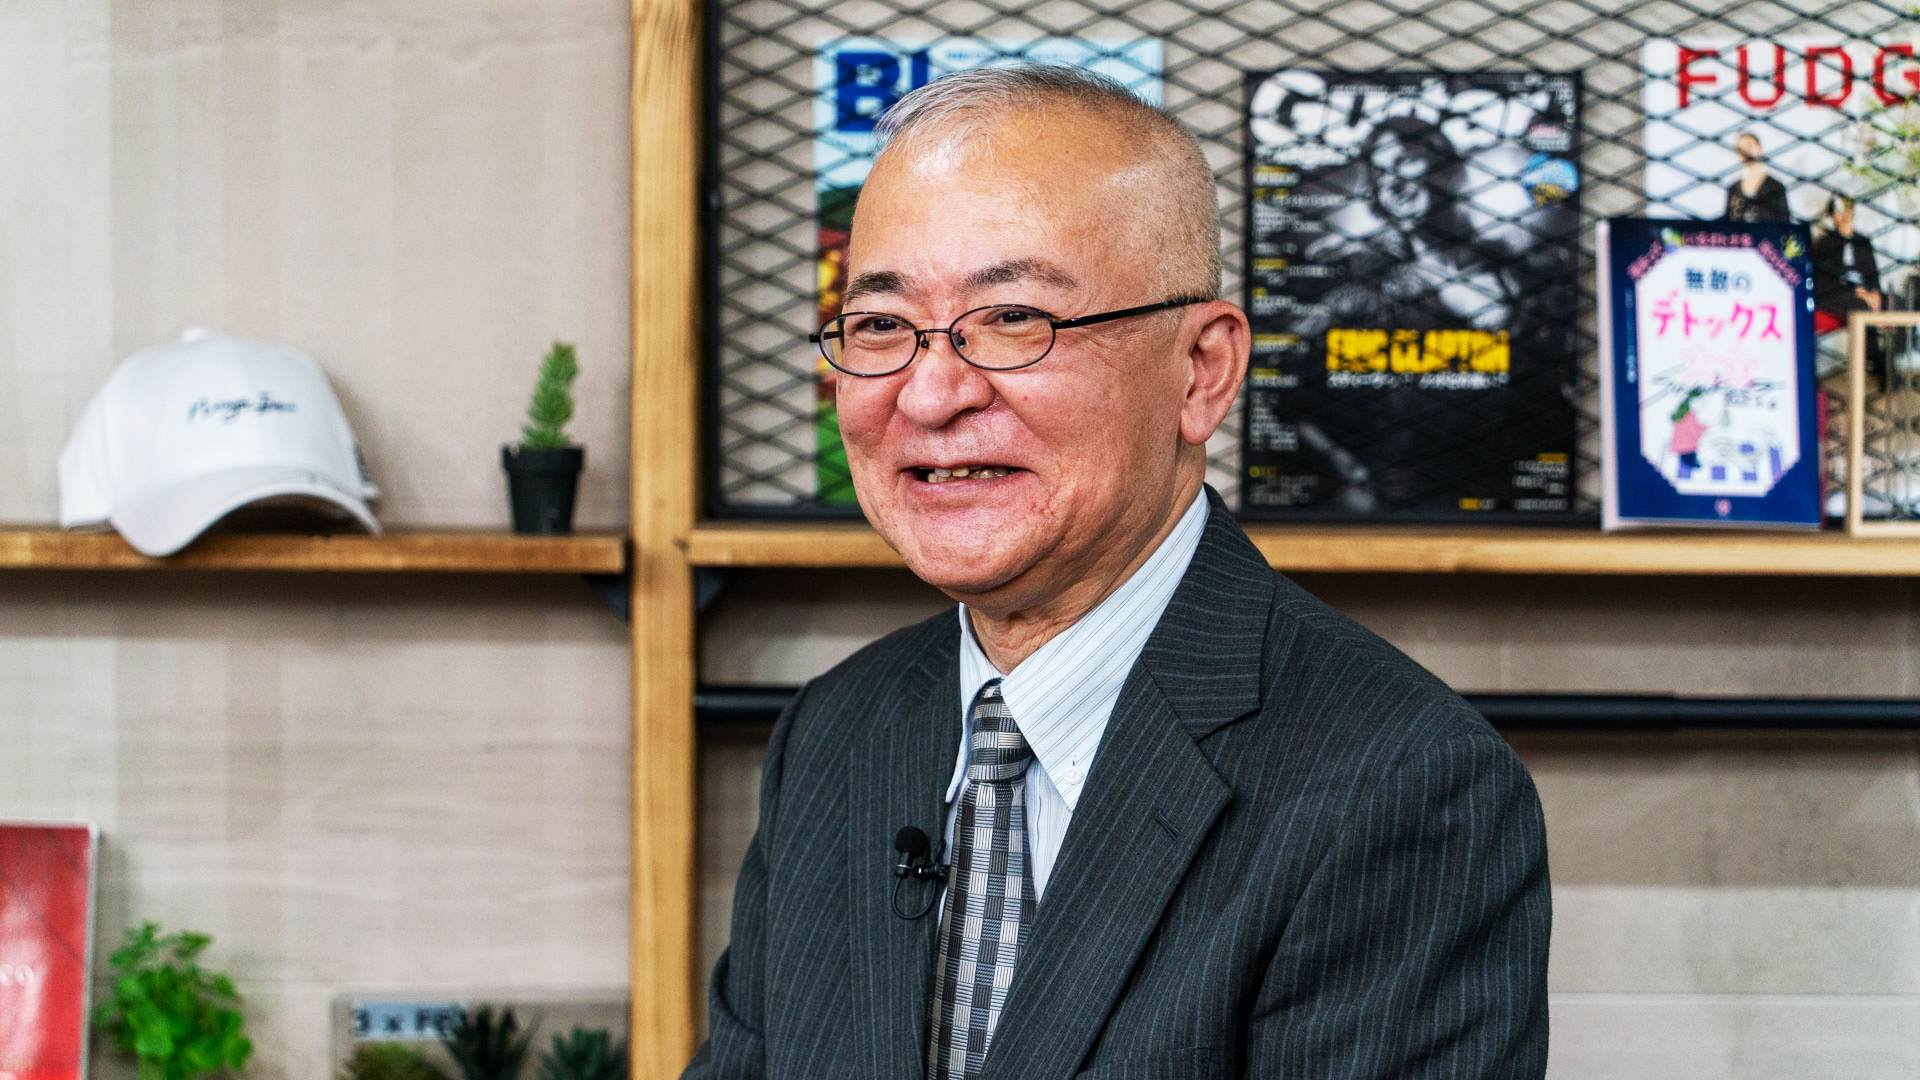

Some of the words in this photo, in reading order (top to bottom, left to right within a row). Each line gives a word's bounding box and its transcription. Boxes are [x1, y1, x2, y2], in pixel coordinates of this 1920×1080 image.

[1652, 290, 1783, 339] デトックス
